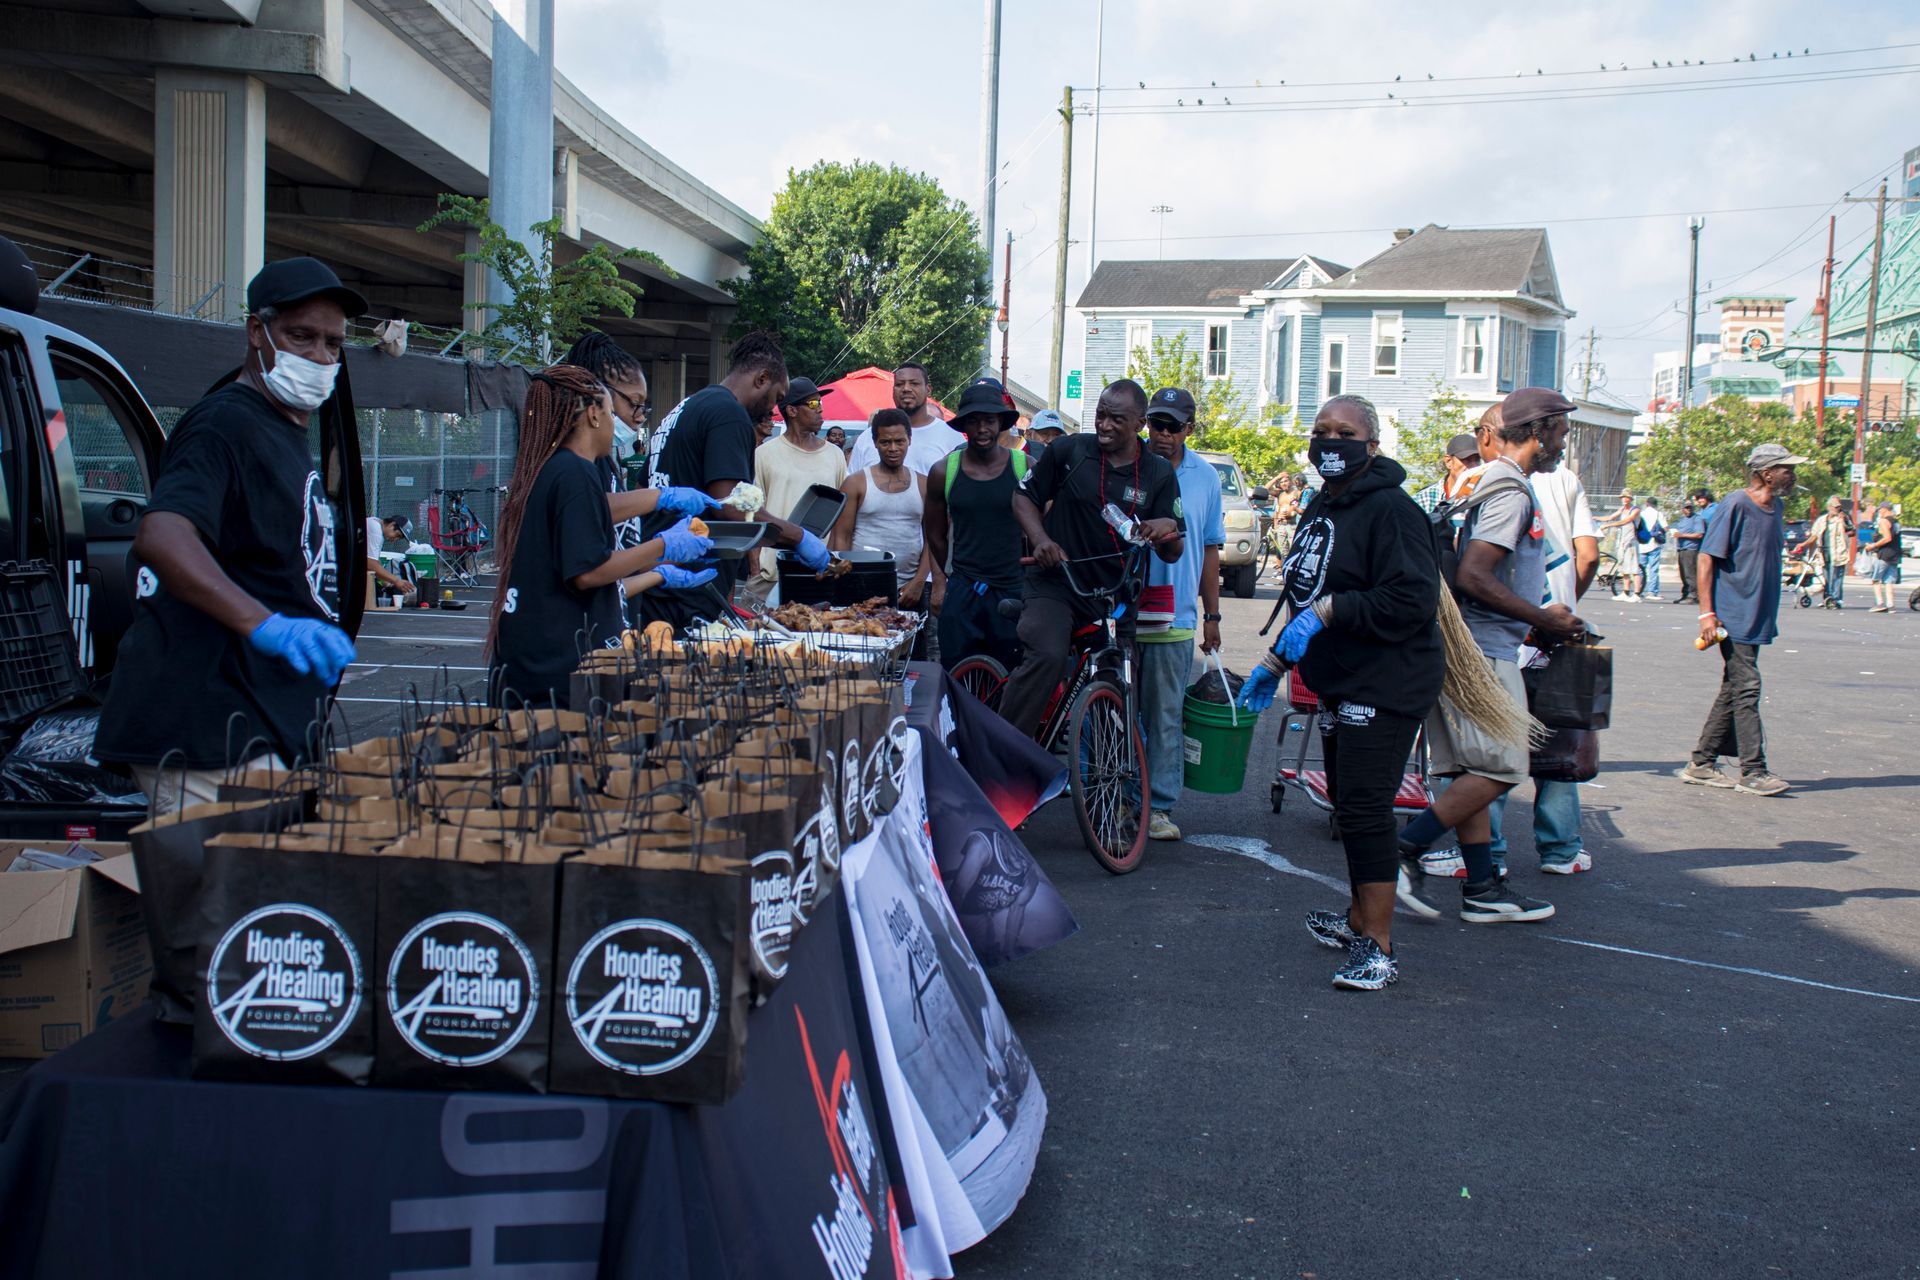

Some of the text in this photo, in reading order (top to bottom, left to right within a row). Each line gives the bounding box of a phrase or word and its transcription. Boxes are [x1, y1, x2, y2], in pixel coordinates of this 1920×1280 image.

[246, 929, 324, 967] Hoodies
[422, 936, 499, 974] Hoodies
[604, 943, 682, 982] Hoodies
[266, 962, 345, 1008] Healing
[442, 970, 521, 1014] Healing
[624, 977, 702, 1024] Healing
[247, 1011, 333, 1023] FOUNDATION
[425, 1016, 511, 1030] FOUNDATION
[605, 1023, 691, 1039] FOUNDATION
